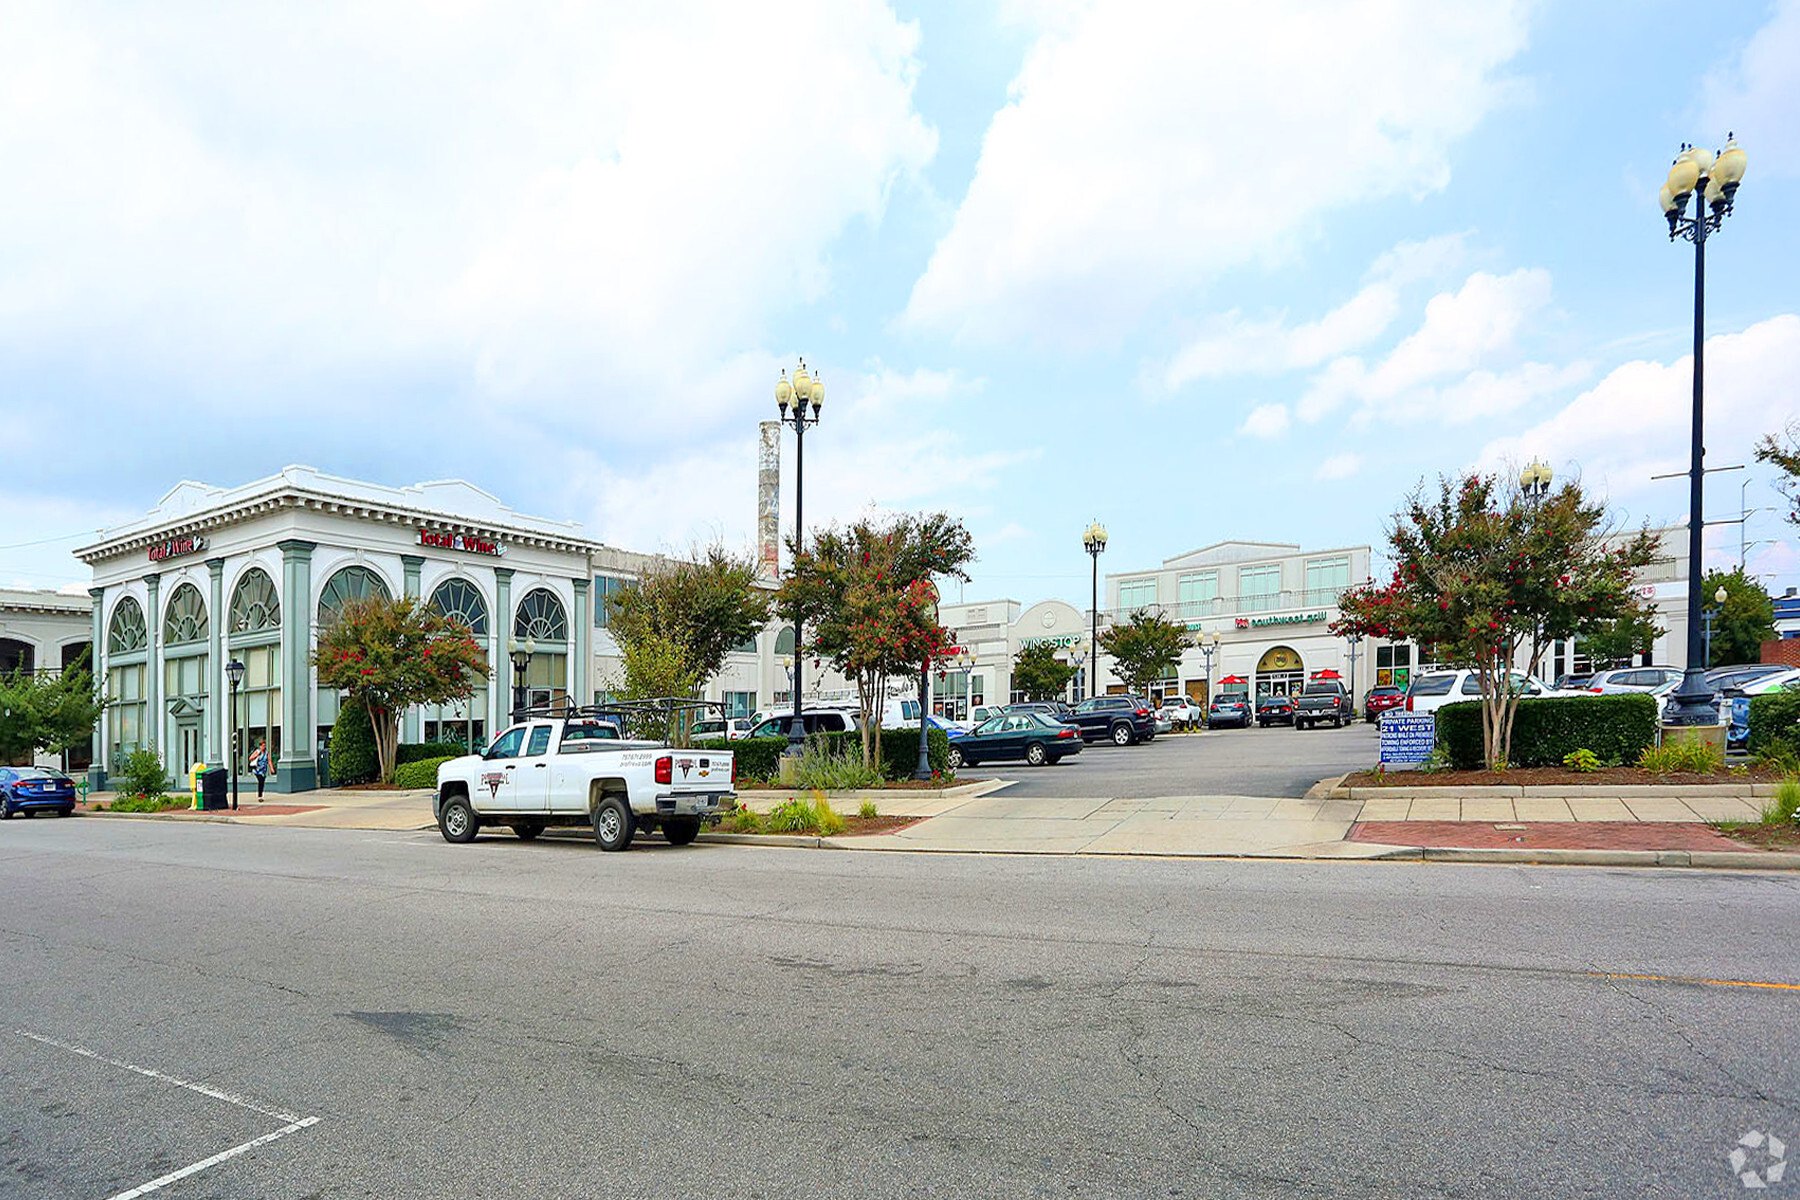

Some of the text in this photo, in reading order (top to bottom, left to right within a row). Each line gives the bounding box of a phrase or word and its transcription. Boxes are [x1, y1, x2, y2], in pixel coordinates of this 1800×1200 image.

[147, 542, 166, 560] Total
[172, 537, 192, 553] Wine
[420, 527, 453, 547] Total
[463, 535, 496, 554] Wine
